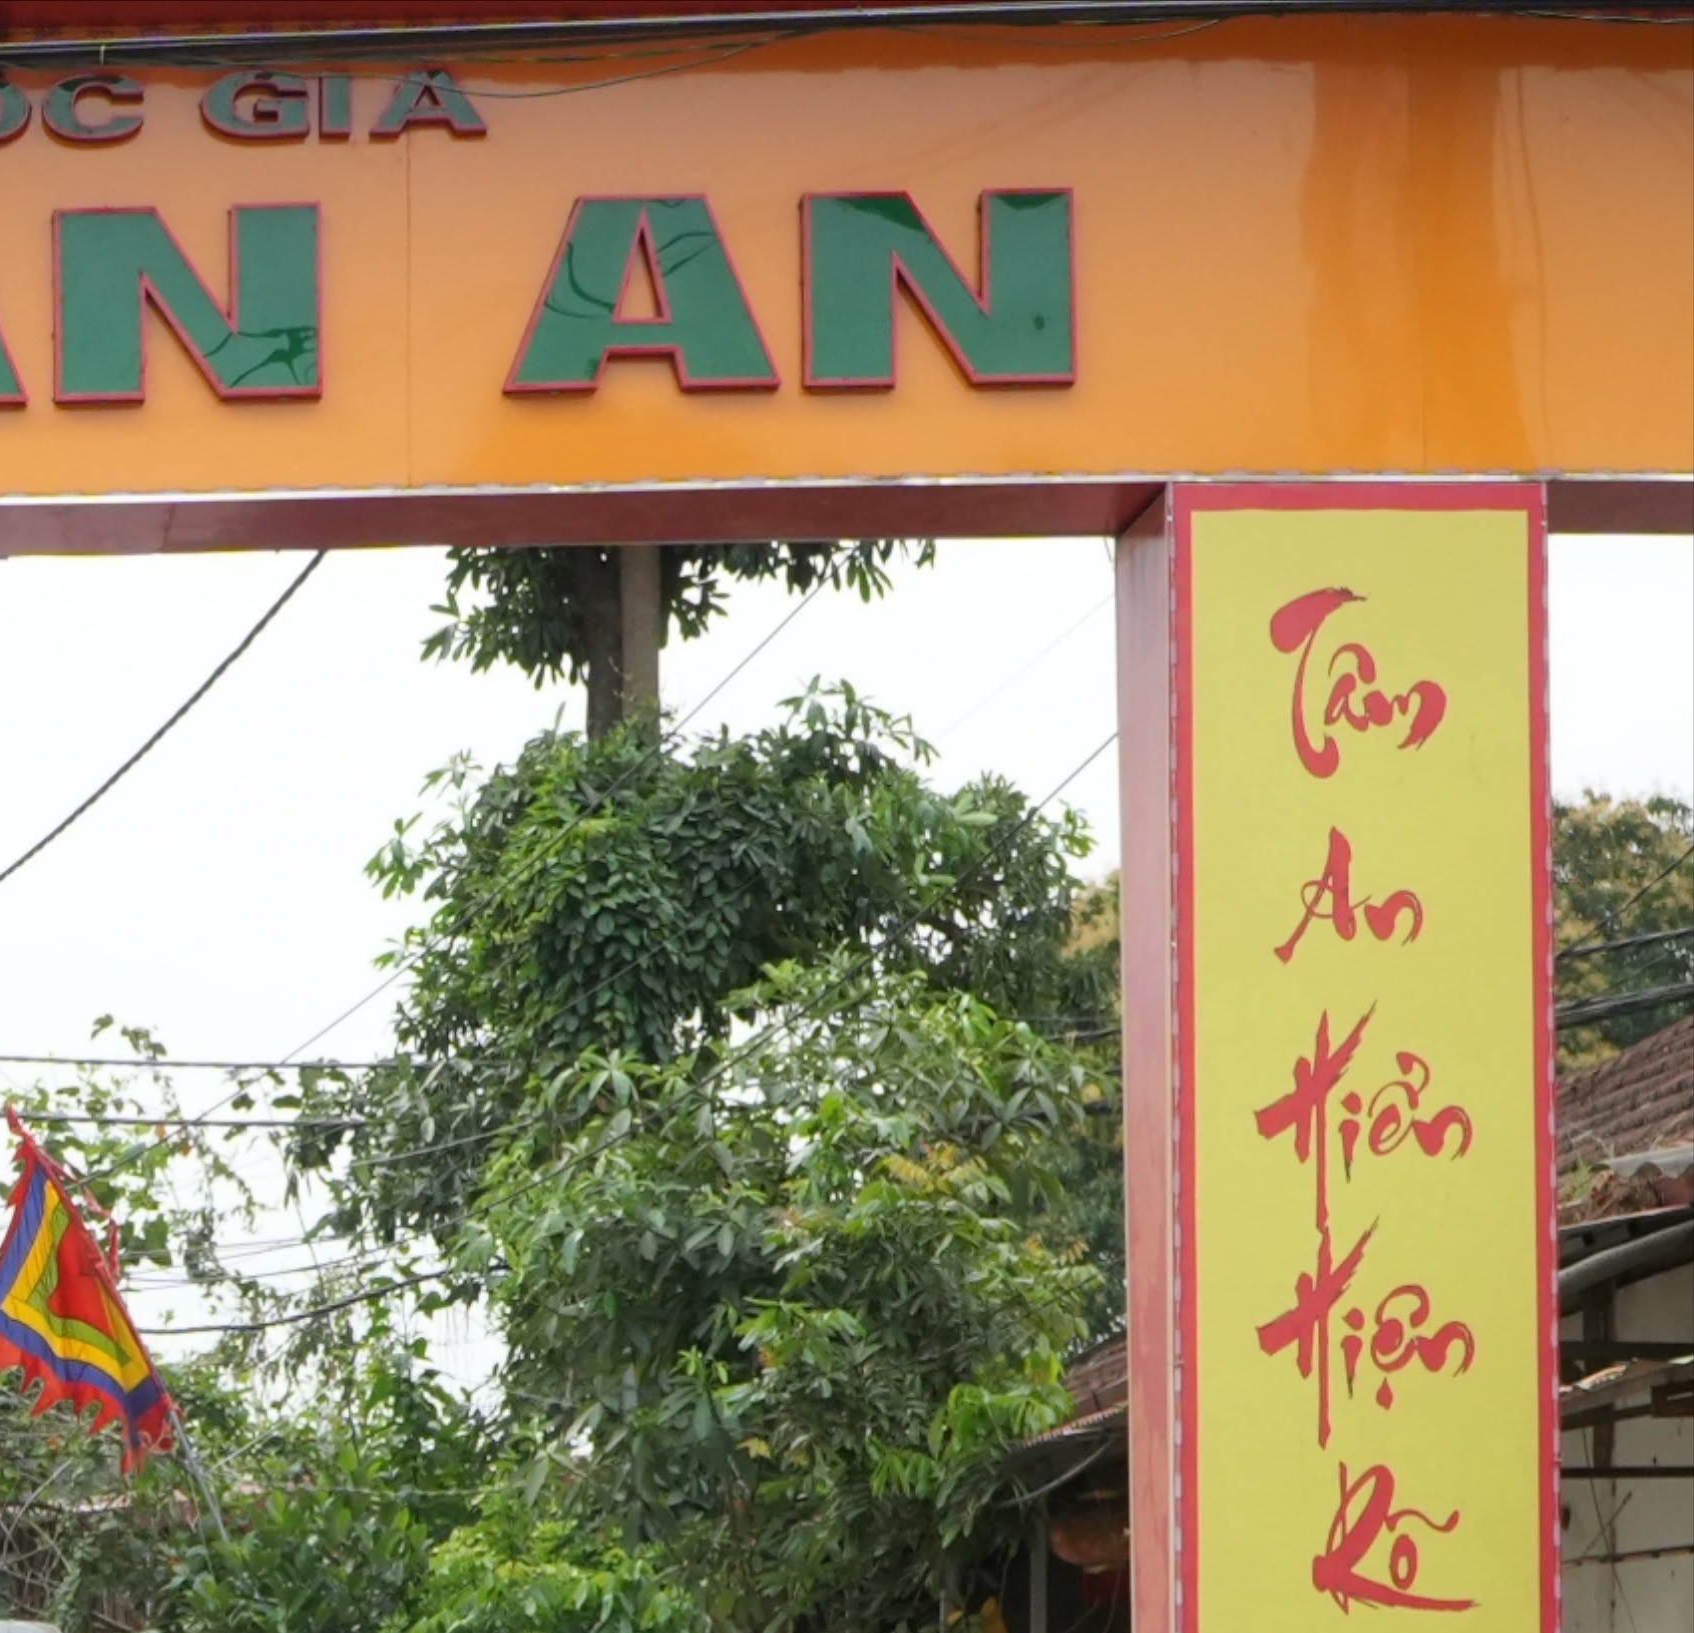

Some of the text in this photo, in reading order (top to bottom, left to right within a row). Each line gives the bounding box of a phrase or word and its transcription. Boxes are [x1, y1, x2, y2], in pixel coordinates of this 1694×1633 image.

[199, 70, 487, 140] GIA
[503, 188, 1076, 395] AN
[1269, 587, 1447, 779] Tâm
[1273, 826, 1423, 964] An
